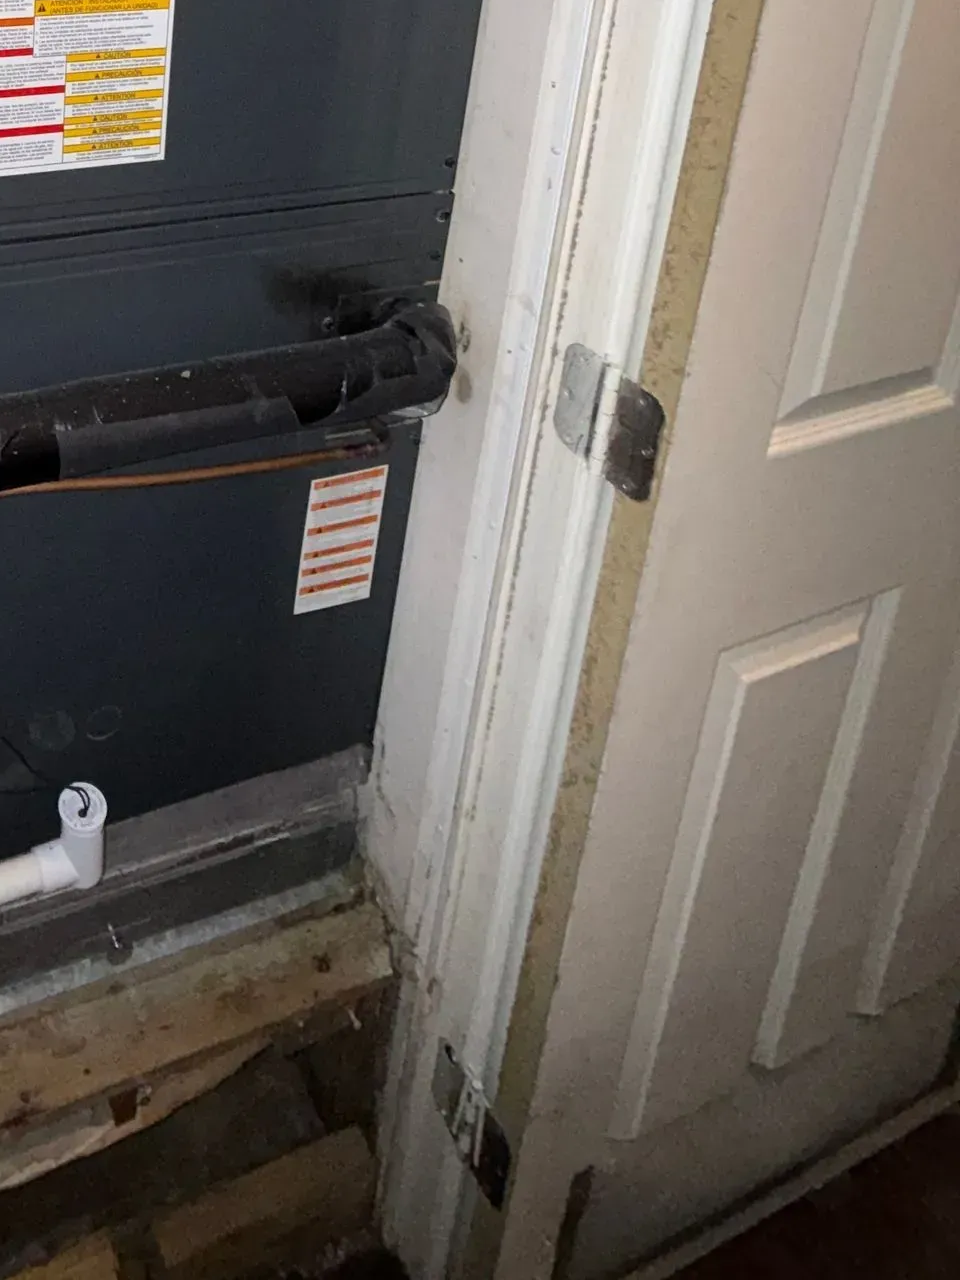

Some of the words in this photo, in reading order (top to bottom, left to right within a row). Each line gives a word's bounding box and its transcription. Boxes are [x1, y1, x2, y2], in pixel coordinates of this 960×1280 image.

[50, 6, 74, 15] (ANTES
[84, 3, 120, 11] FUNCIONAR
[103, 51, 132, 59] CAUTION
[102, 92, 136, 101] ATTENTION
[100, 114, 128, 122] CAUTION
[98, 140, 134, 150] ATTENTION
